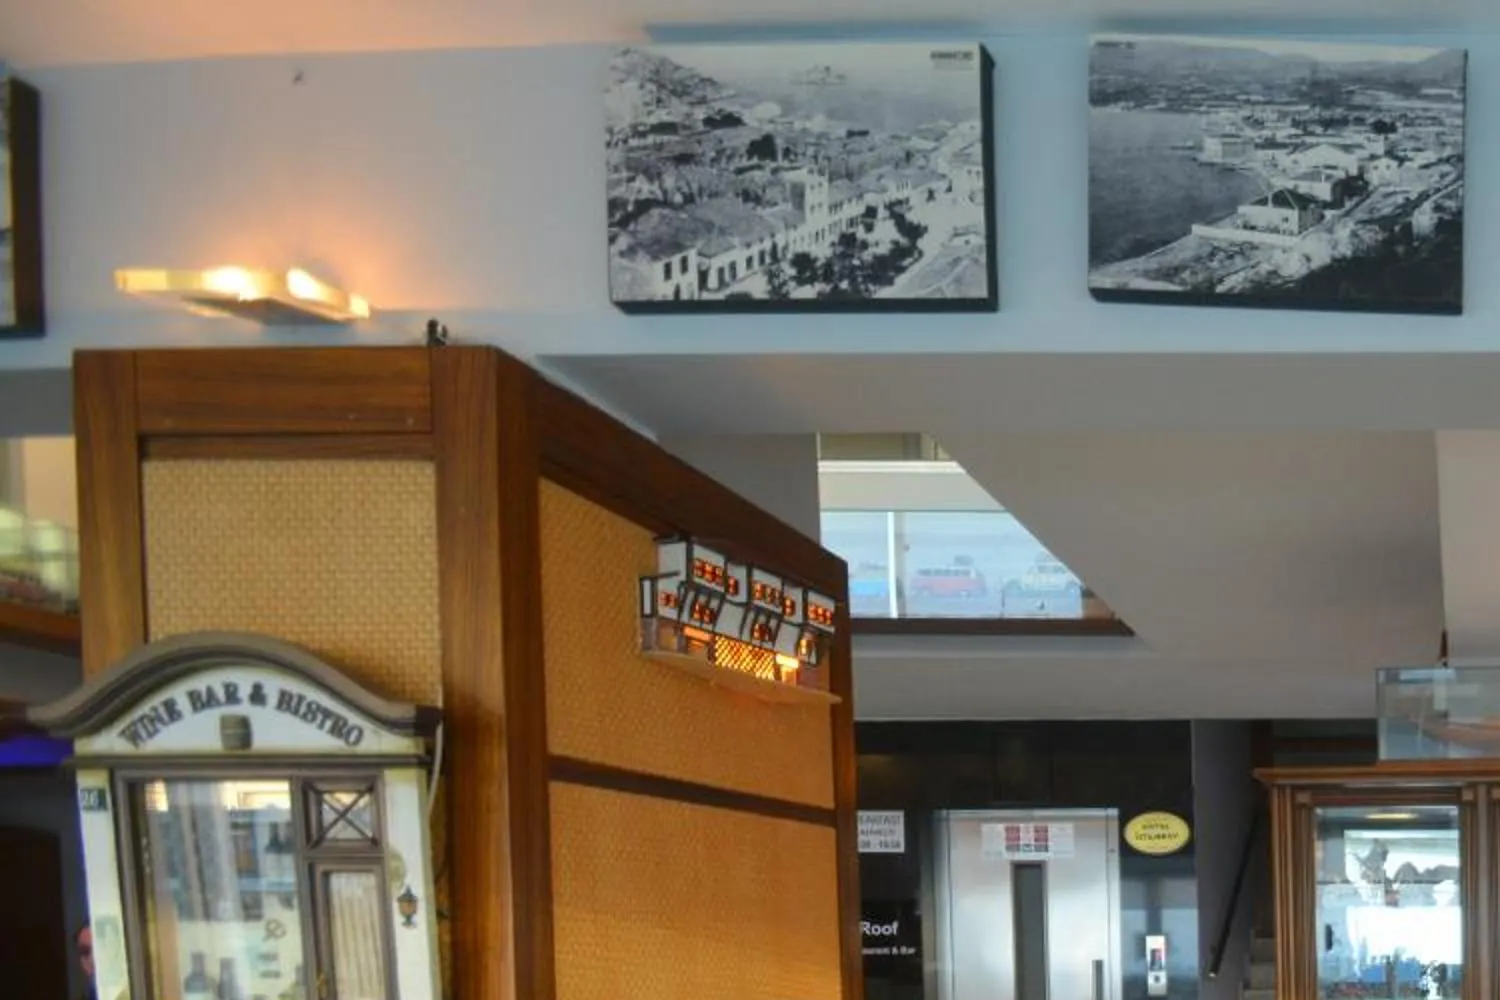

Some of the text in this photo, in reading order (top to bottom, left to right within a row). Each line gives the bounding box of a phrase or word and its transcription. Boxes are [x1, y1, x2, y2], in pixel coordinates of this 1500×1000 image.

[118, 681, 365, 749] WINE BAR & BISTRO
[859, 920, 899, 936] Roof
